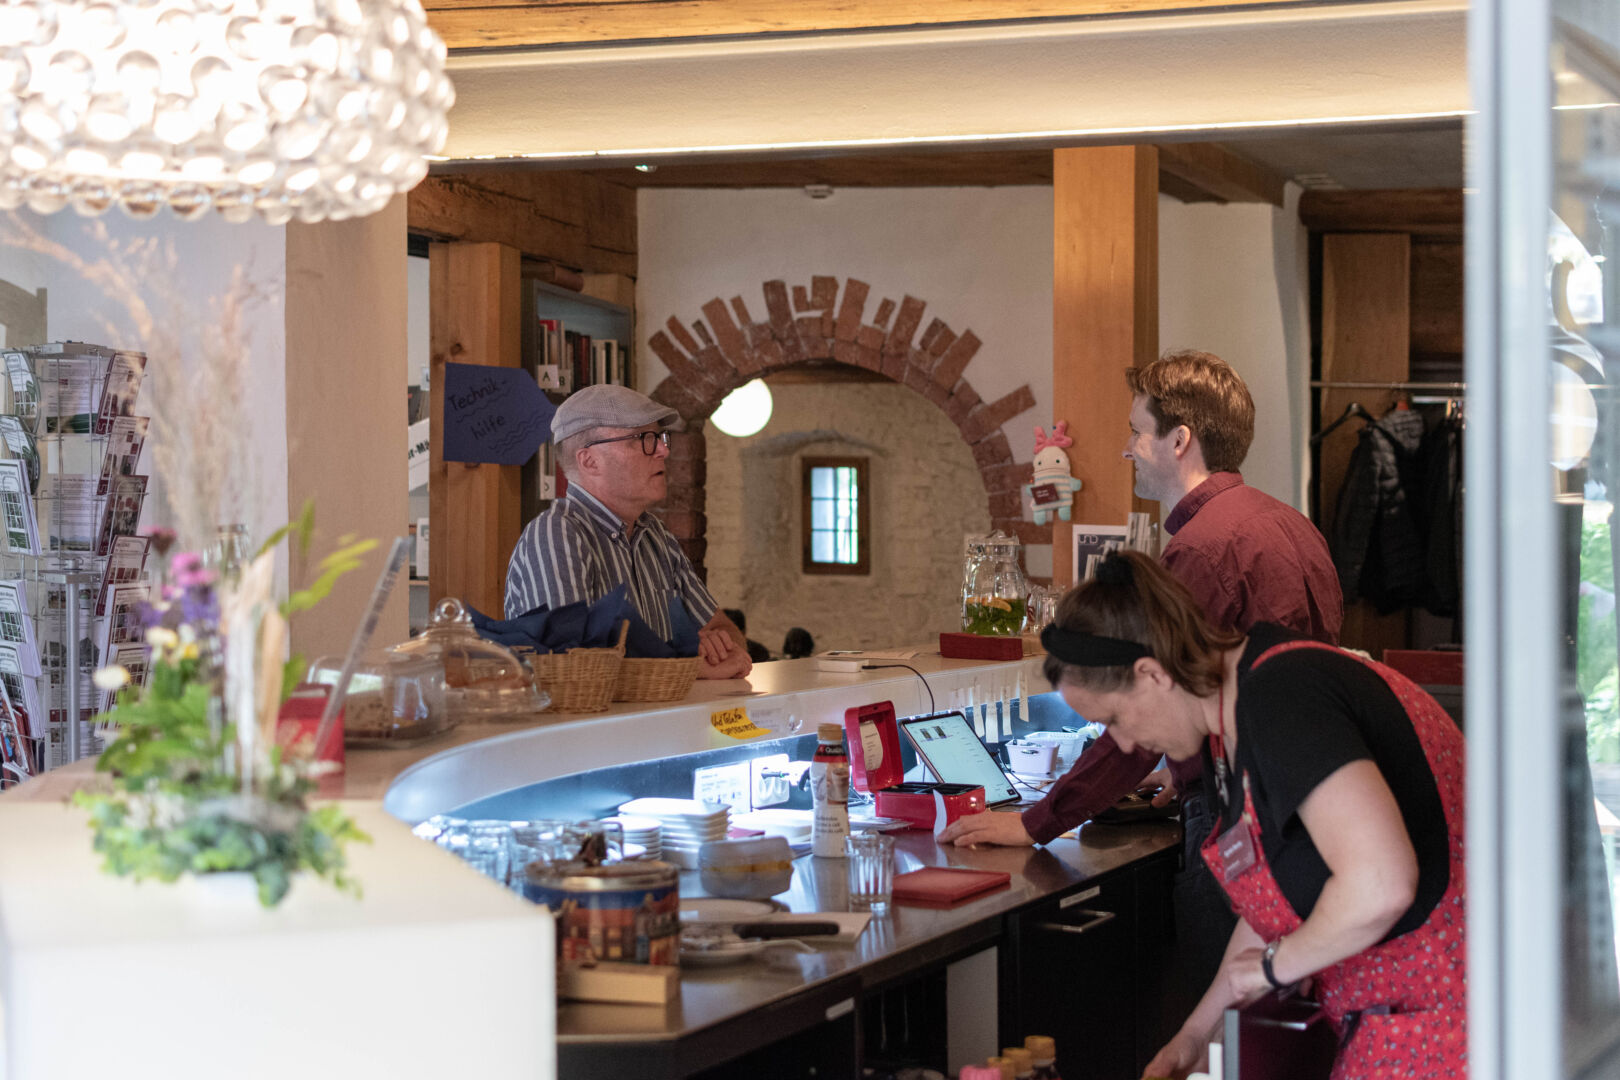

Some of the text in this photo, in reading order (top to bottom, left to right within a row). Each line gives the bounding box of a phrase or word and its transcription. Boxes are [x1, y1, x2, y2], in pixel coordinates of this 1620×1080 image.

[542, 371, 551, 382] A
[558, 375, 566, 387] B
[448, 377, 507, 411] Technik-
[470, 415, 505, 441] hilfe
